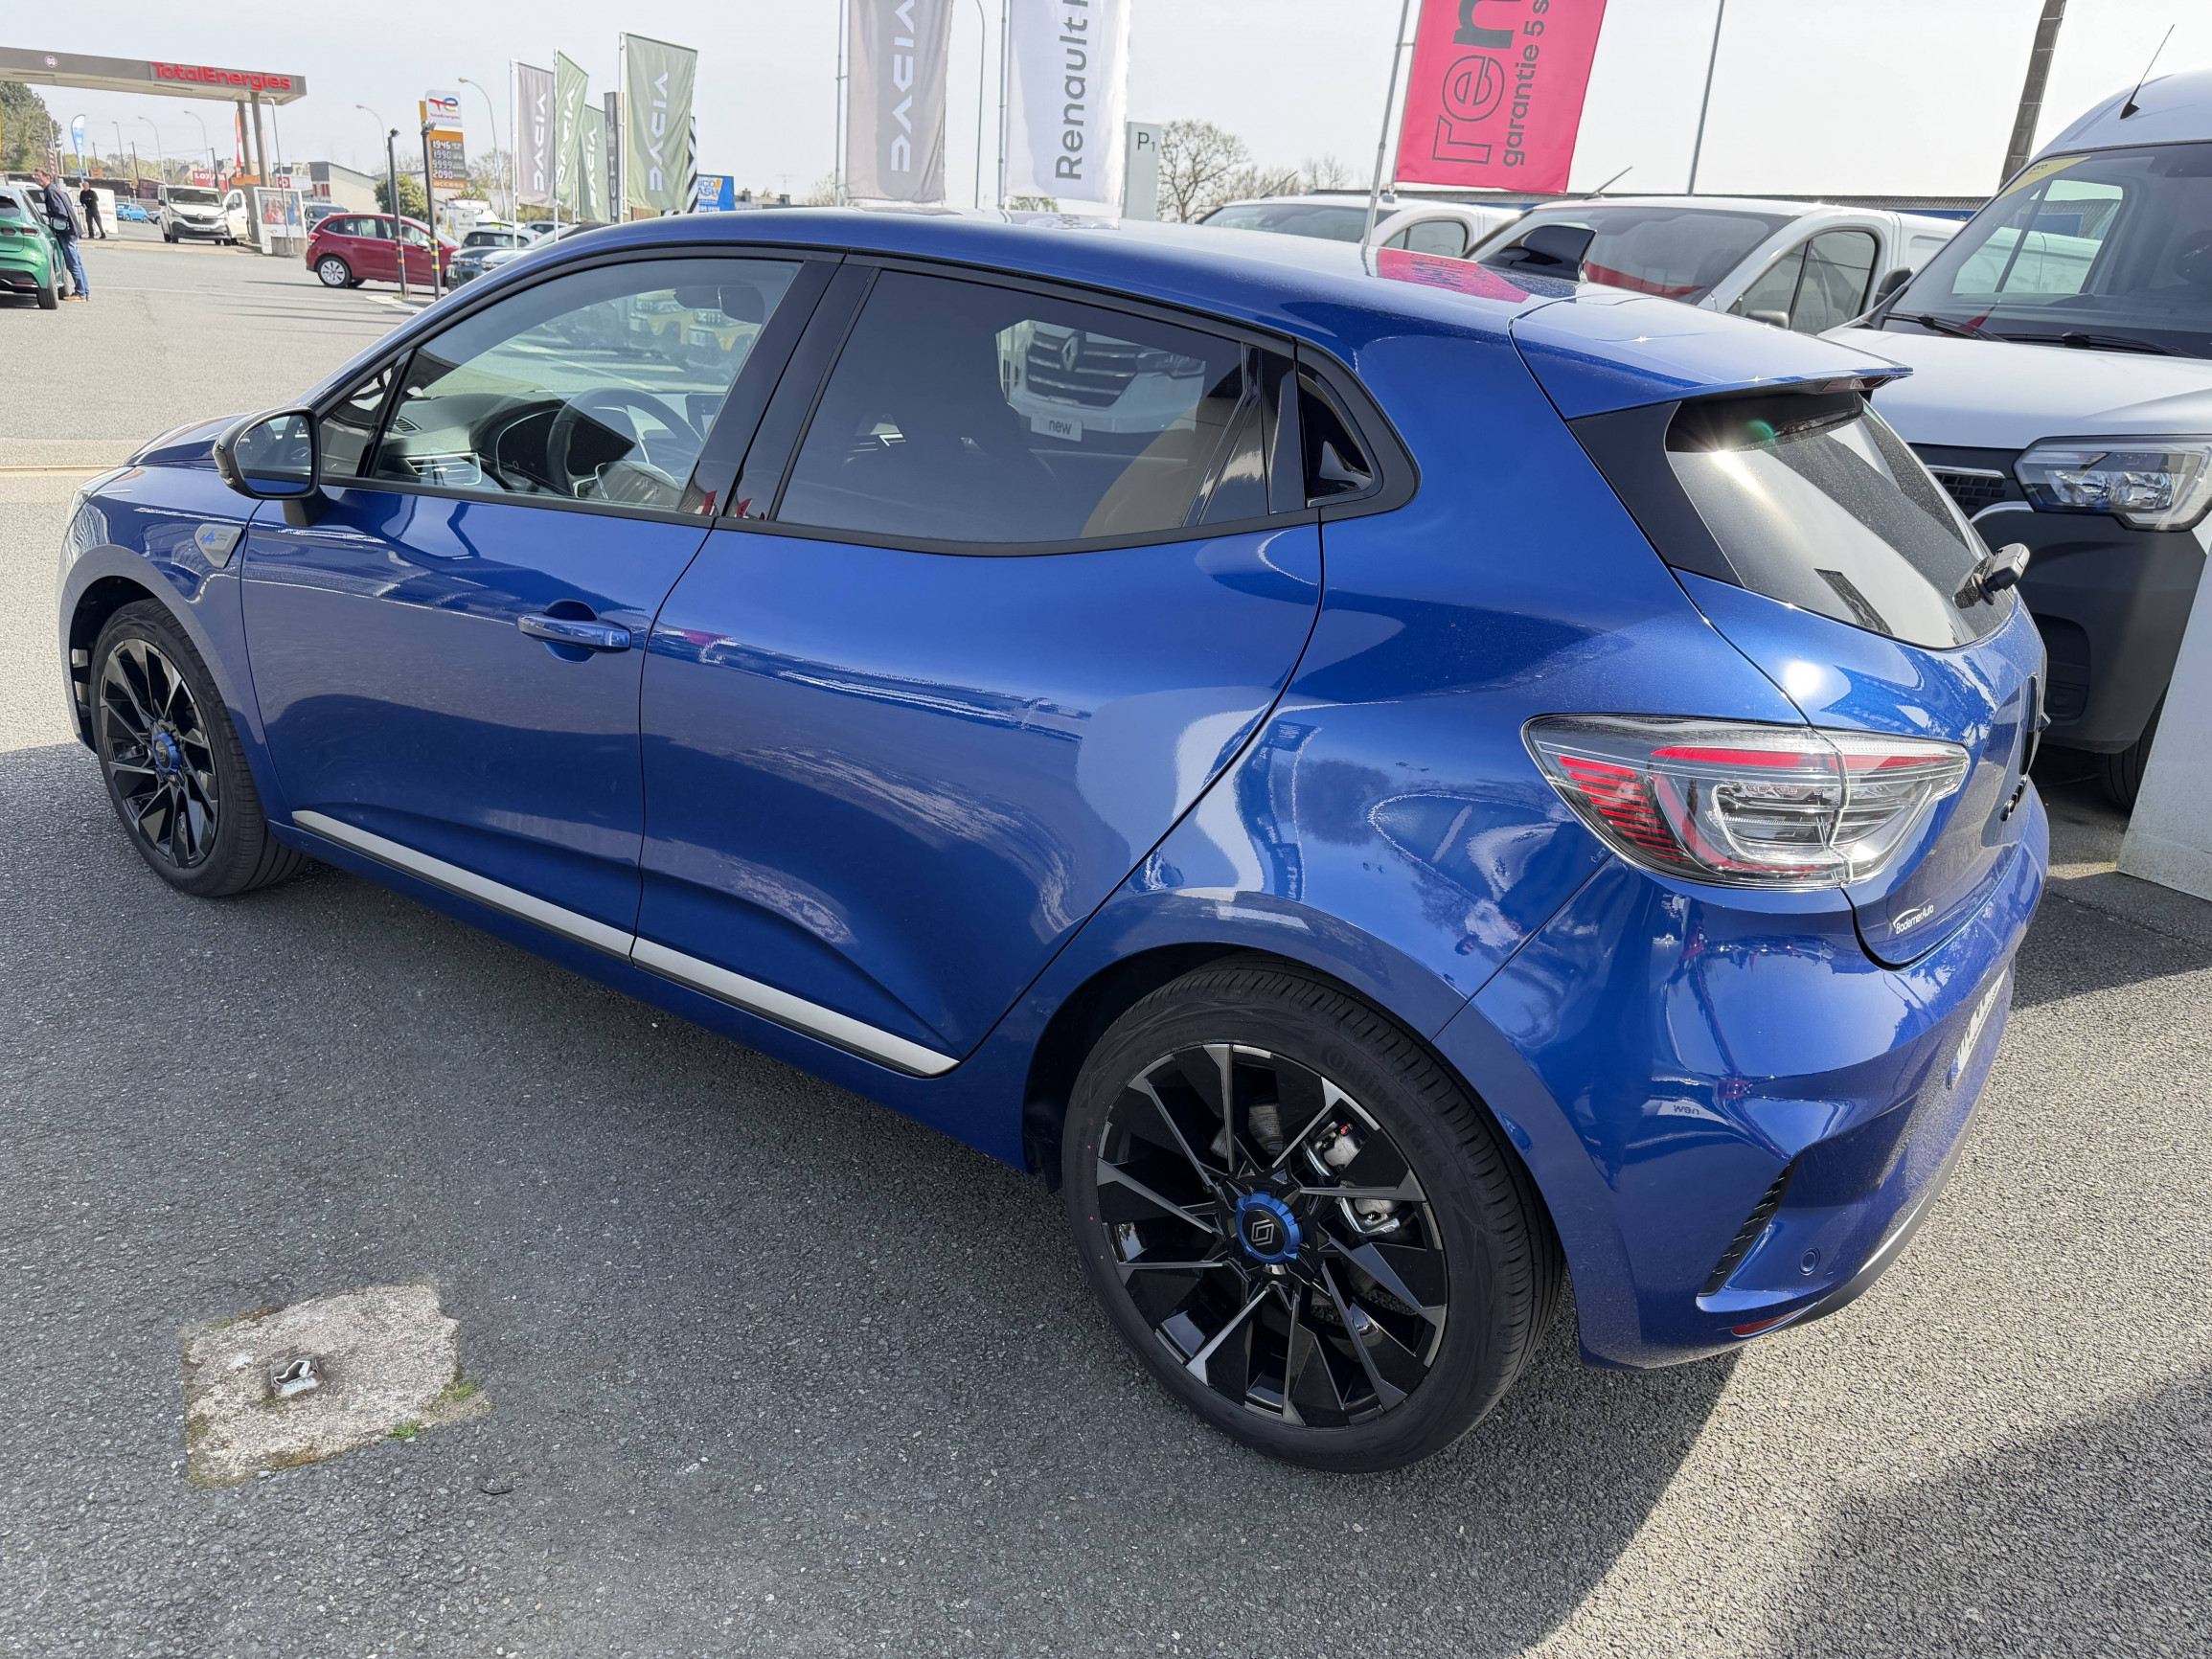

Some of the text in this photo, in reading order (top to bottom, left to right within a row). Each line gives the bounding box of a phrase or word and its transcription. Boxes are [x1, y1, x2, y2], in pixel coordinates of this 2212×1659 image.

[150, 61, 291, 91] TotalEnergies
[650, 71, 669, 192] DACIA
[891, 0, 916, 172] DACIA
[1055, 16, 1088, 180] Renault
[1502, 44, 1539, 168] garantie
[1524, 20, 1544, 36] 5
[533, 92, 546, 192] DACIA
[1048, 420, 1072, 436] new
